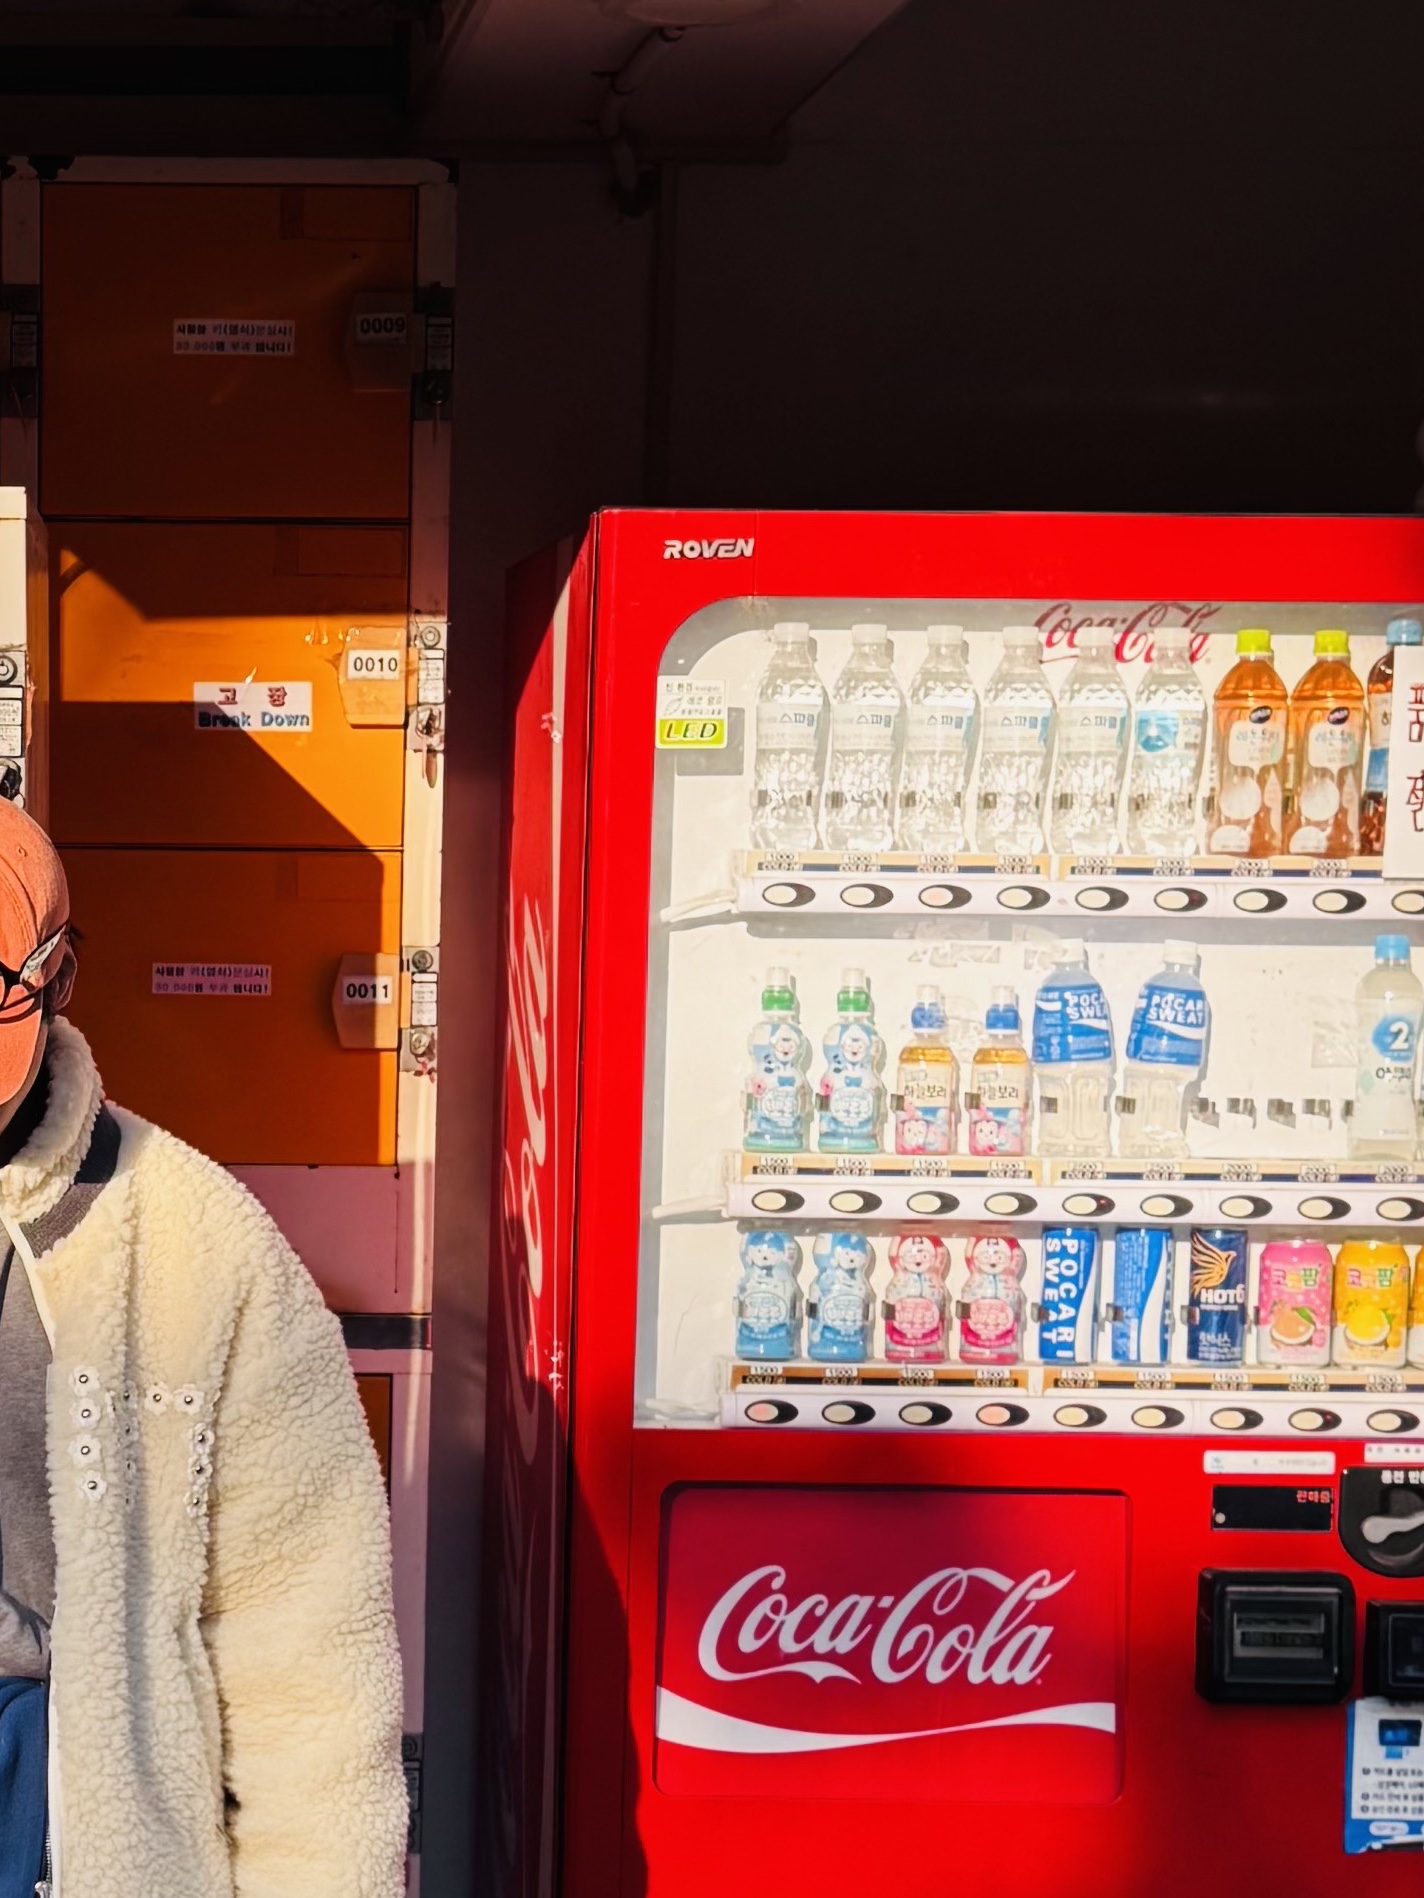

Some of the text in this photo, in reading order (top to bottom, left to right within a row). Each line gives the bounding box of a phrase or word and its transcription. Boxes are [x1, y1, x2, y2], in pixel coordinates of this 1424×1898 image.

[360, 316, 406, 335] 0009
[663, 537, 755, 560] ROVEN
[353, 656, 398, 673] 0010
[261, 711, 310, 727] Down
[666, 722, 718, 740] LED
[346, 983, 389, 999] 0011
[1147, 1006, 1204, 1025] SWEAT
[1389, 1021, 1409, 1050] 2
[1042, 1238, 1061, 1344] SWEAT
[1056, 1239, 1079, 1358] POCARI
[1200, 1284, 1245, 1304] HOT6
[753, 1366, 779, 1375] 1500
[829, 1369, 854, 1378] 1500
[979, 1370, 1006, 1378] 1500
[1063, 1370, 1090, 1380] 1500
[1141, 1372, 1168, 1381] 1500
[1218, 1373, 1246, 1383] 1500
[1294, 1374, 1322, 1384] 1500
[1370, 1375, 1399, 1385] 1500
[698, 1563, 1076, 1686] Coca-Cola
